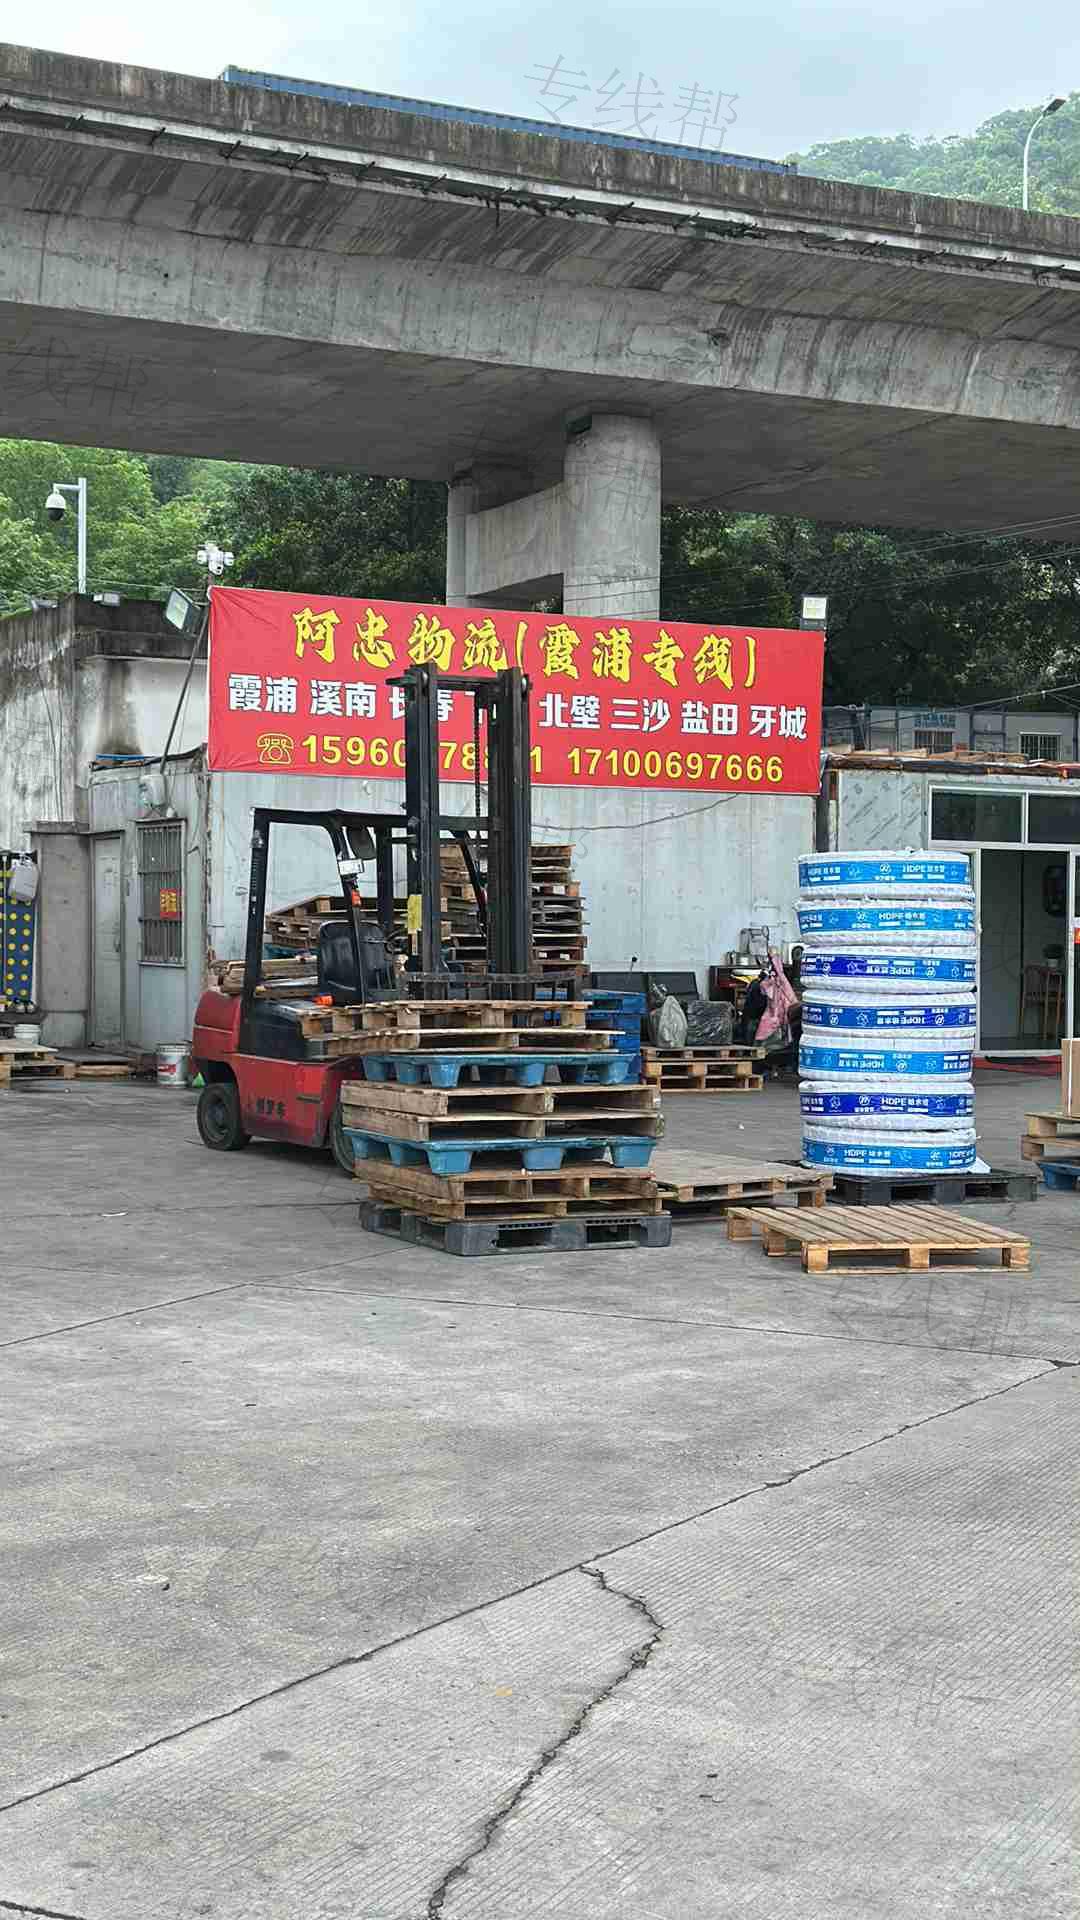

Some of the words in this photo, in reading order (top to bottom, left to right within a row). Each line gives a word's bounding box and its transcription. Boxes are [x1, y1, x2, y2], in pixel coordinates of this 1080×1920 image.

[228, 673, 298, 714] 霞浦
[309, 679, 377, 718] 溪南
[539, 693, 602, 729] 北壁
[610, 697, 671, 732] 三沙
[681, 700, 738, 736] 盐田
[749, 704, 807, 740] 牙城
[302, 735, 543, 774] 15960781
[568, 747, 784, 782] 17100697666
